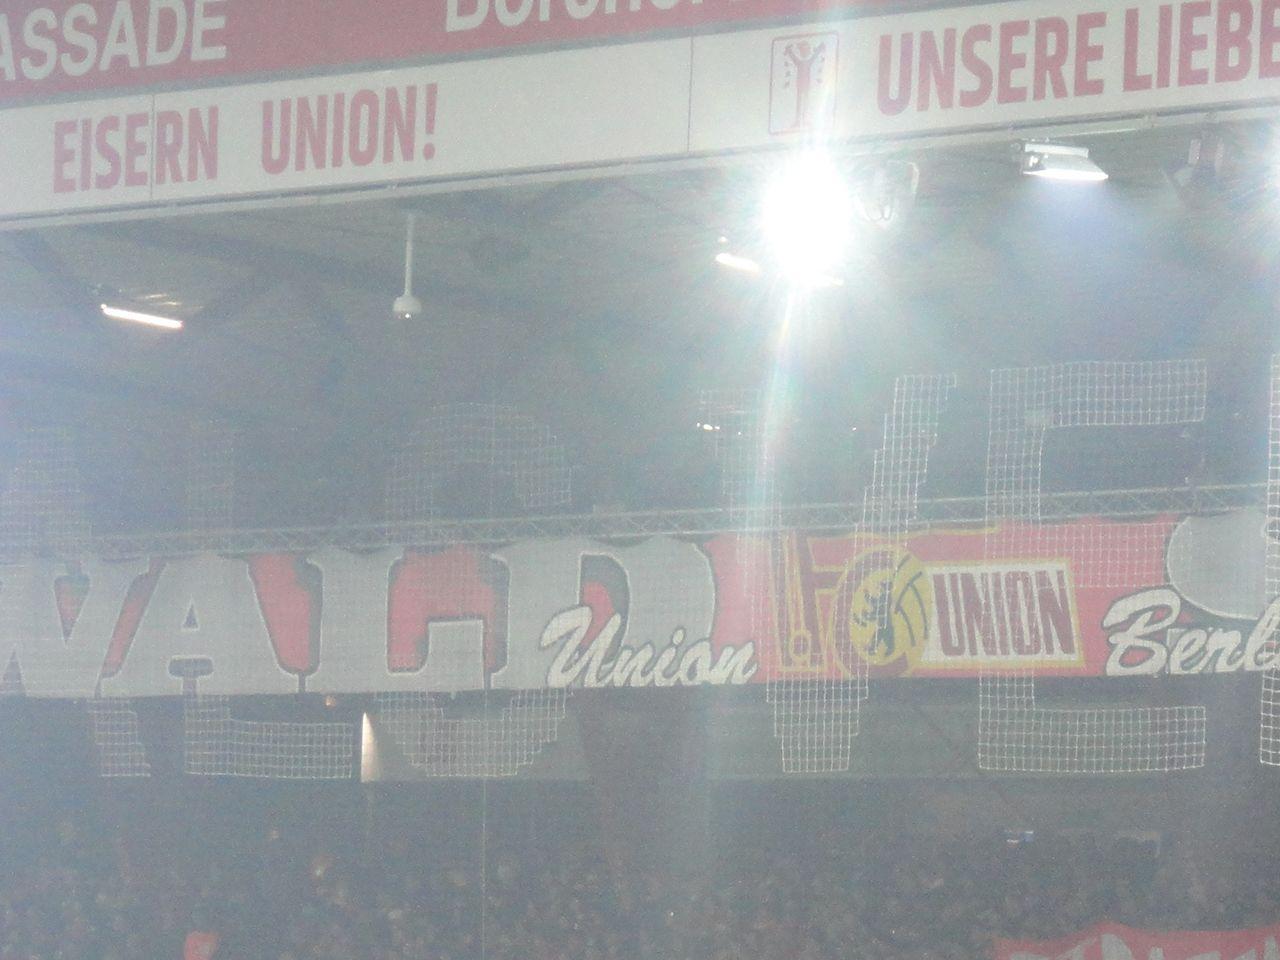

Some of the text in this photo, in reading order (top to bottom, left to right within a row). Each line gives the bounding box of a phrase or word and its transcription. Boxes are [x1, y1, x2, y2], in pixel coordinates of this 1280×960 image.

[53, 105, 219, 194] EISERN
[260, 82, 438, 175] UNION!
[875, 14, 1107, 117] UNSERE
[540, 606, 758, 689] Union
[932, 568, 1077, 657] UNION
